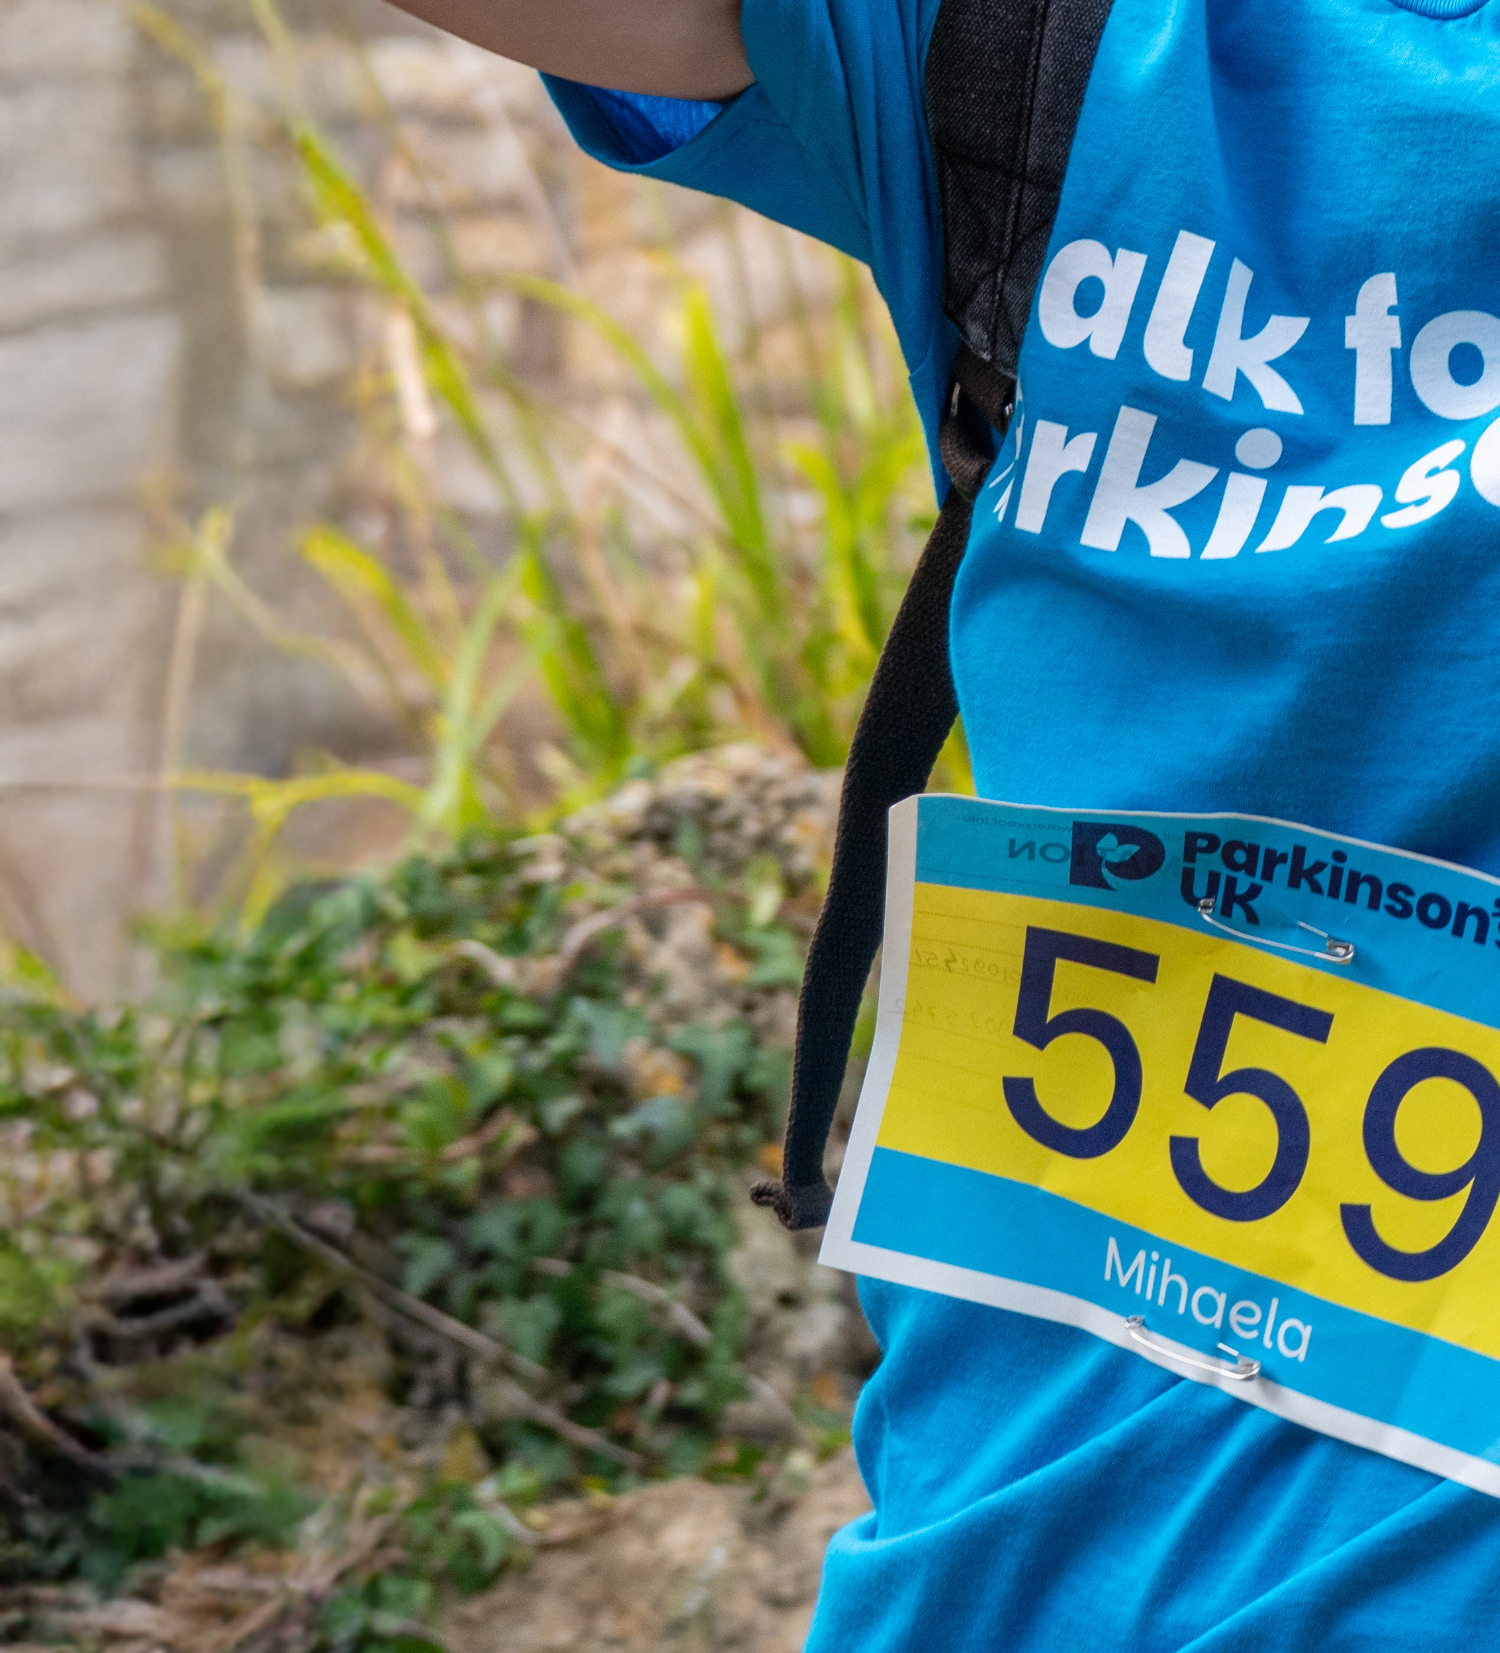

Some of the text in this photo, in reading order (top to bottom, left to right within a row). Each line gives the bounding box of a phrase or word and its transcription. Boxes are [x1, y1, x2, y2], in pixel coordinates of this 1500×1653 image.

[1038, 230, 1309, 415] alk
[1180, 866, 1263, 925] UK
[1104, 1236, 1312, 1362] Mihaela
